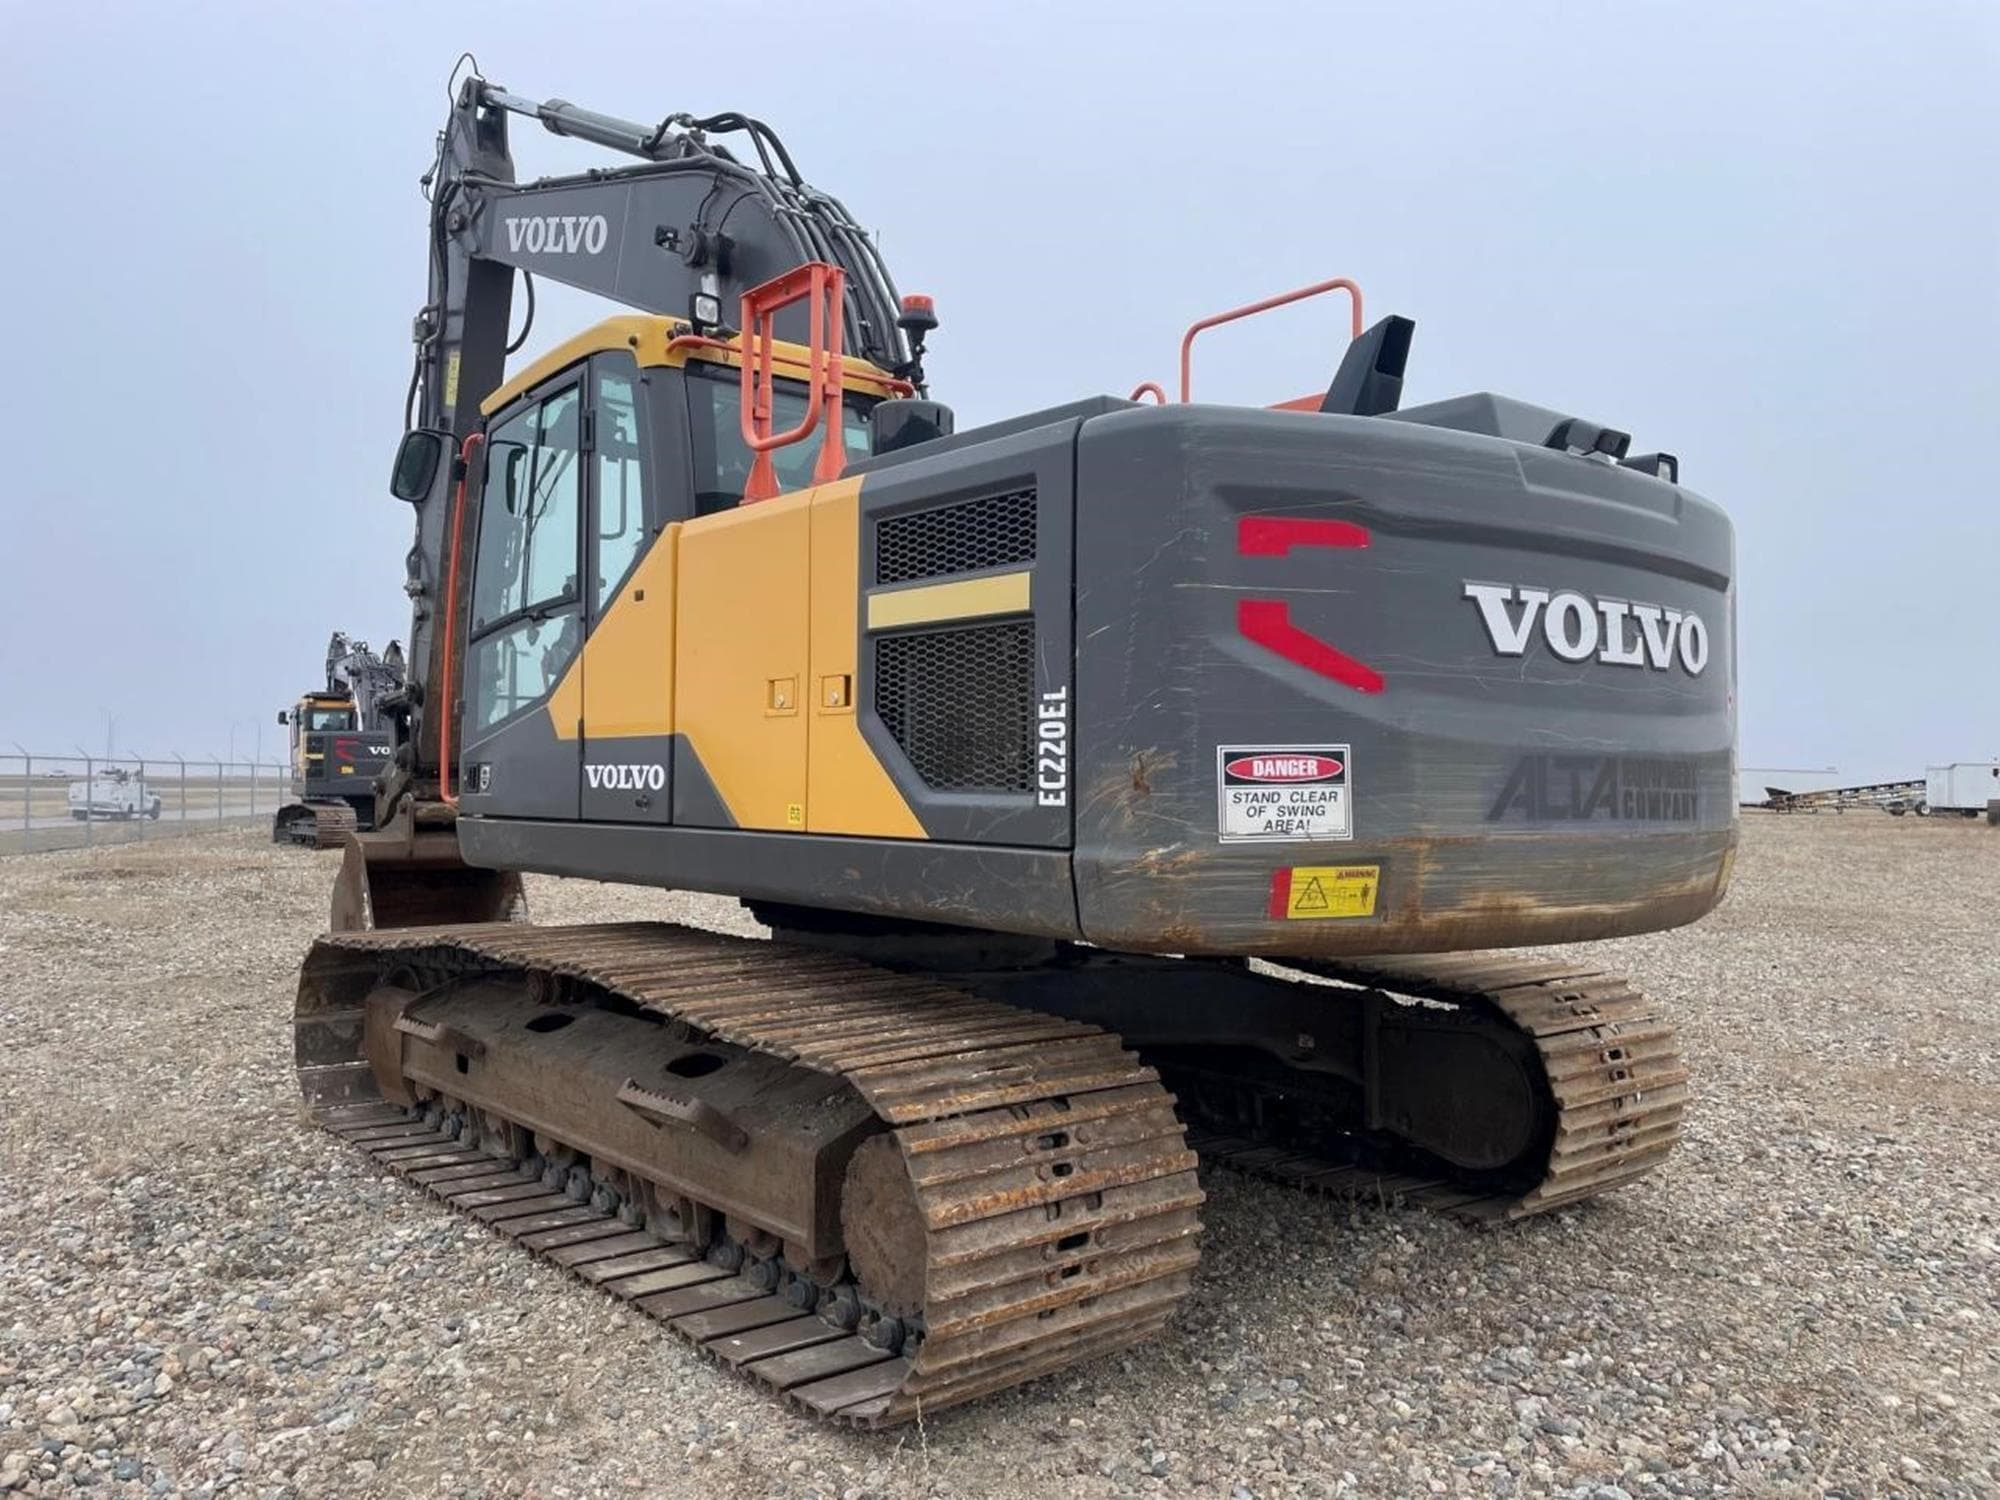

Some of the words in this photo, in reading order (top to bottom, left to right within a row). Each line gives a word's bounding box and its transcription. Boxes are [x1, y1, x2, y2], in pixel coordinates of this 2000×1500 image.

[505, 215, 608, 254] VOLVO
[1463, 581, 1709, 675] VOLVO
[368, 746, 391, 756] VO
[1038, 686, 1066, 807] EC220EL
[584, 764, 665, 790] VOLVO
[1252, 759, 1318, 777] DANGER
[1232, 792, 1281, 804] STAND
[1289, 791, 1338, 803] CLEAR
[1484, 754, 1619, 821] ALTA
[1246, 806, 1267, 818] OF
[1276, 805, 1326, 818] SWING
[1263, 819, 1311, 832] AREA!
